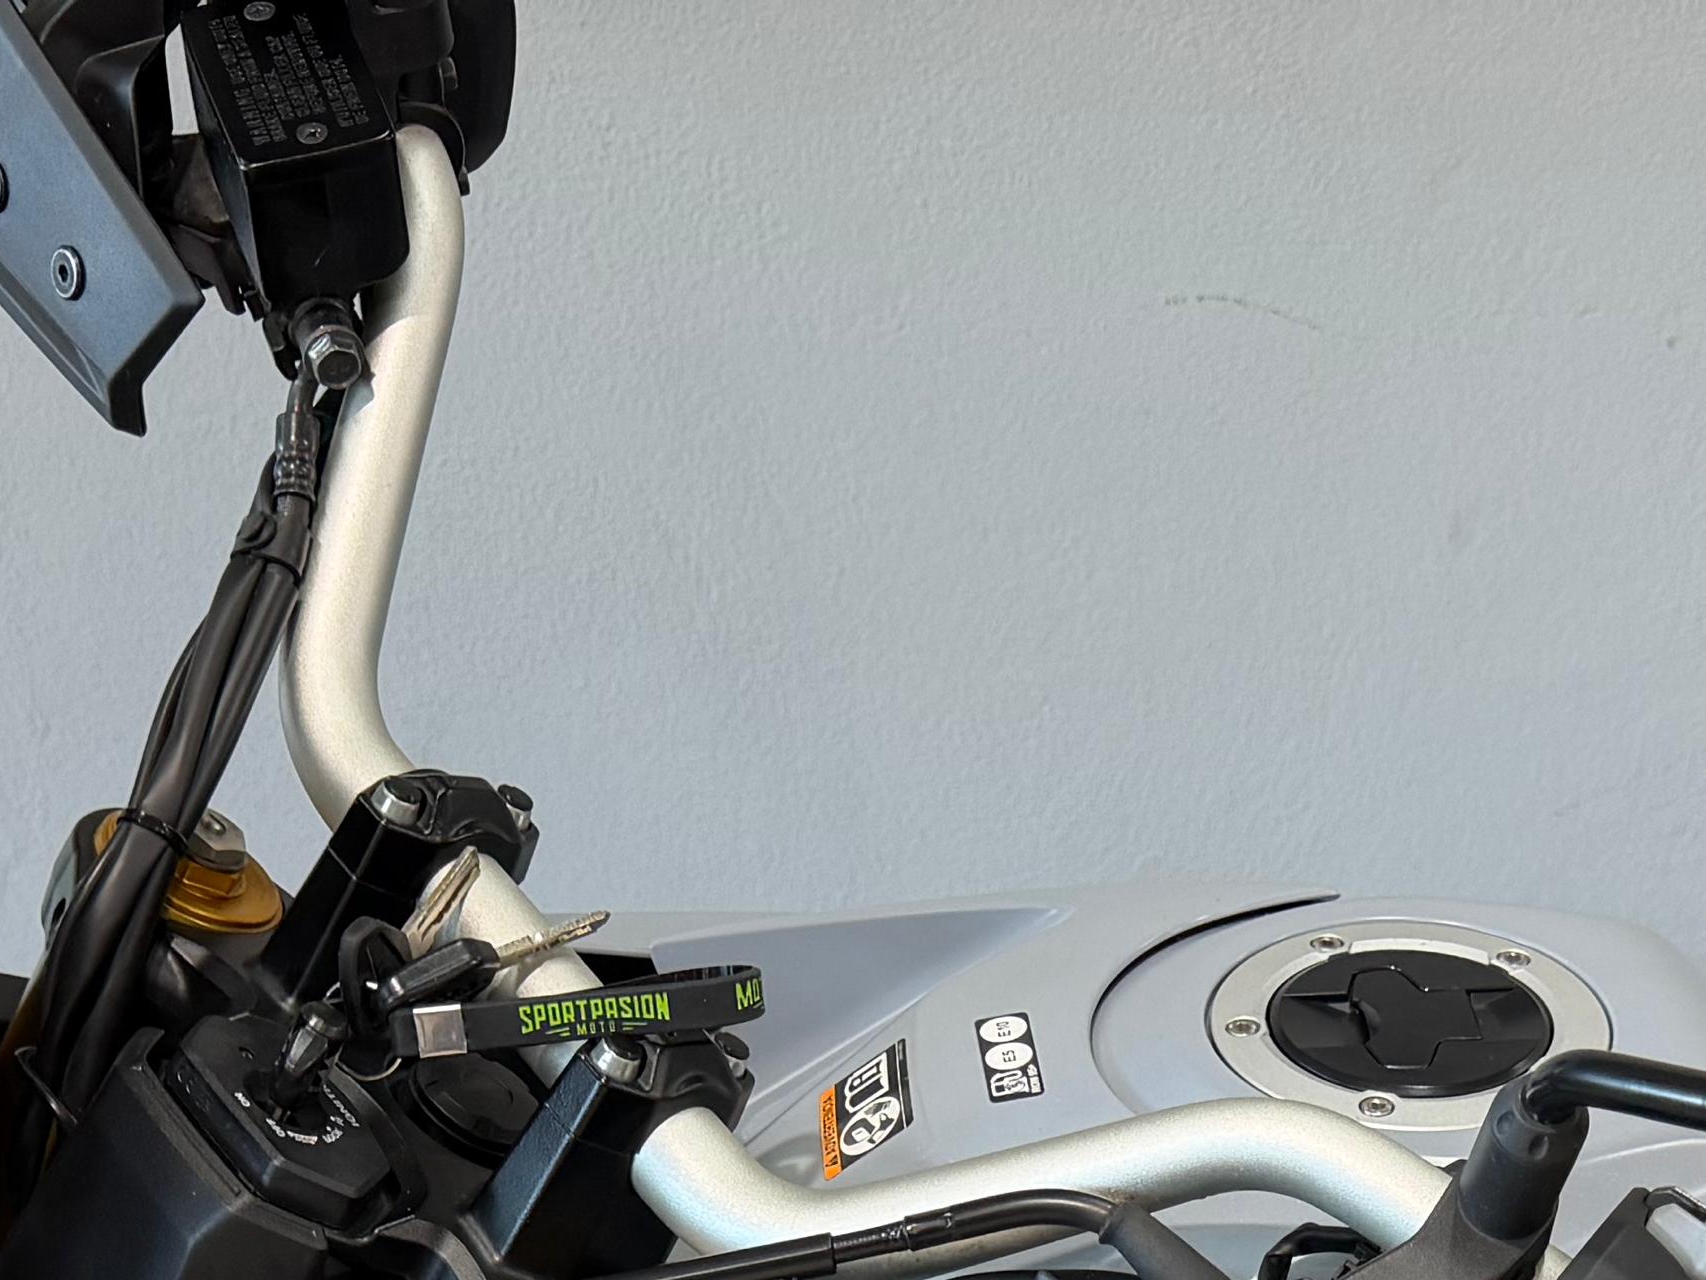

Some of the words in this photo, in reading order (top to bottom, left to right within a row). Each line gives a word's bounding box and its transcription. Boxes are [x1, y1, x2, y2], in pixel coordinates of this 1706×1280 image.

[518, 992, 671, 1035] SPORTPASION
[576, 1020, 617, 1036] MOTO
[1002, 1050, 1016, 1062] E5
[233, 1091, 251, 1108] ON
